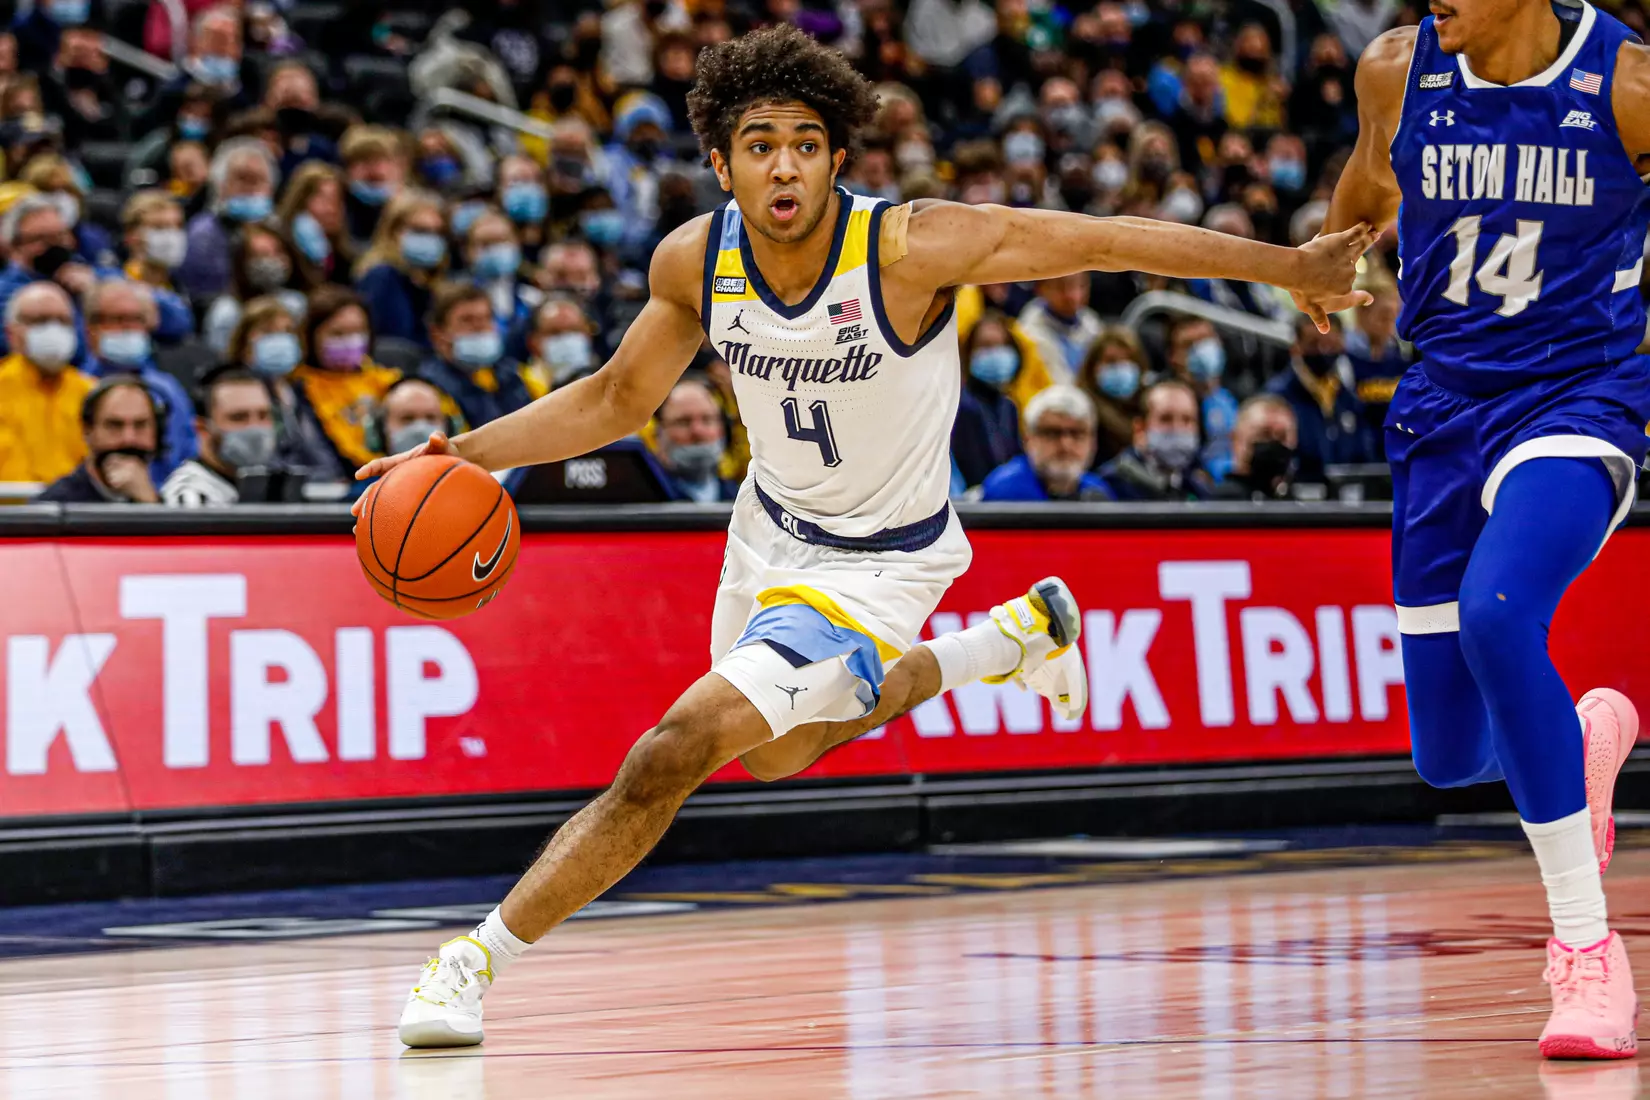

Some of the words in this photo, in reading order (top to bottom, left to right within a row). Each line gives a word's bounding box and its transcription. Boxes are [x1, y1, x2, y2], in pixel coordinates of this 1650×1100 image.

[1419, 80, 1451, 88] CHANGE
[1562, 117, 1597, 128] EAST
[1567, 110, 1592, 120] BIG
[1421, 143, 1507, 201] SETON
[1514, 144, 1595, 206] HALL
[1441, 214, 1544, 318] 14
[715, 285, 745, 293] CHANGE
[836, 329, 869, 341] EAST
[838, 324, 861, 334] BIG
[718, 340, 883, 391] Marquette
[780, 397, 842, 467] 4
[1157, 560, 1404, 728] TRIP
[119, 573, 480, 769] TRIP
